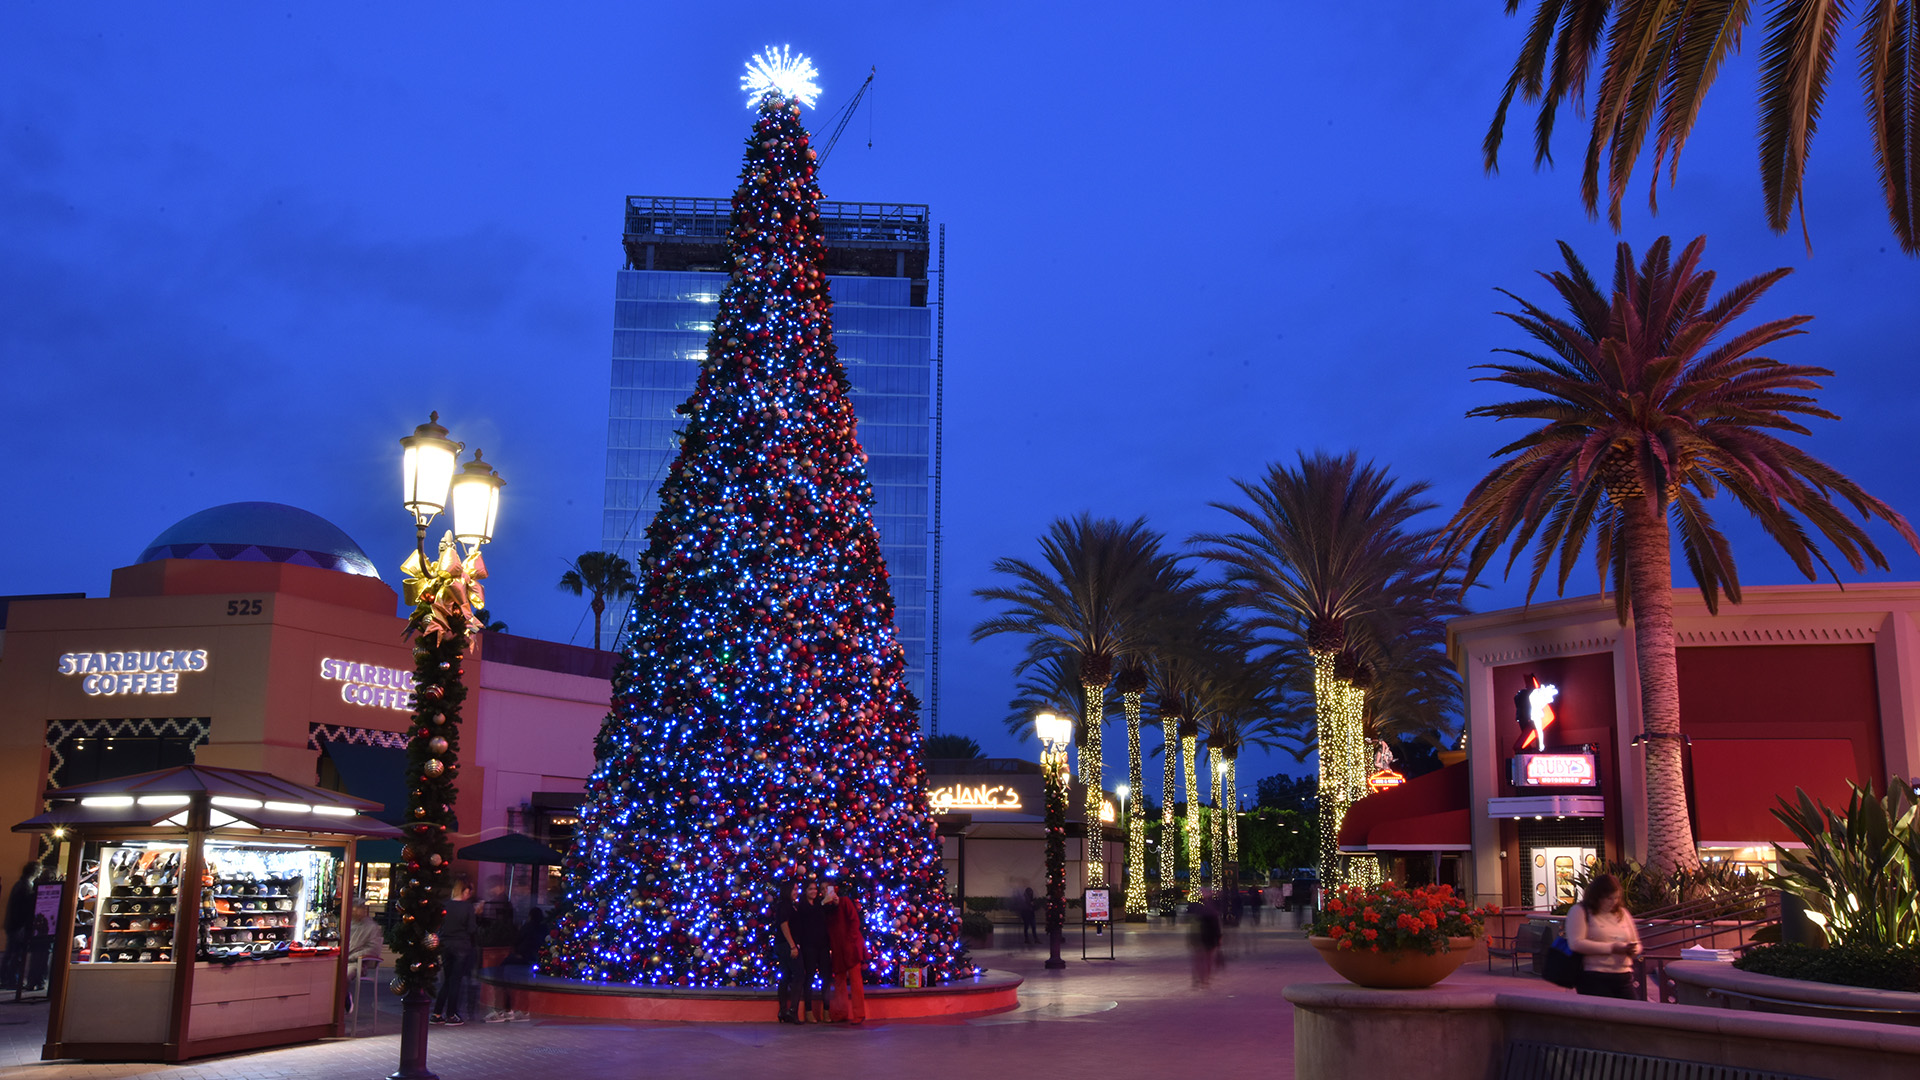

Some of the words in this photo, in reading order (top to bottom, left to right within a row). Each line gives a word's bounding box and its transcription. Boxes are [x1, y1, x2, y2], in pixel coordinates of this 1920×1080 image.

[226, 599, 263, 616] 525
[57, 649, 208, 674] STARBUCKS
[320, 657, 417, 690] STARBUC
[82, 673, 179, 696] COFFEE
